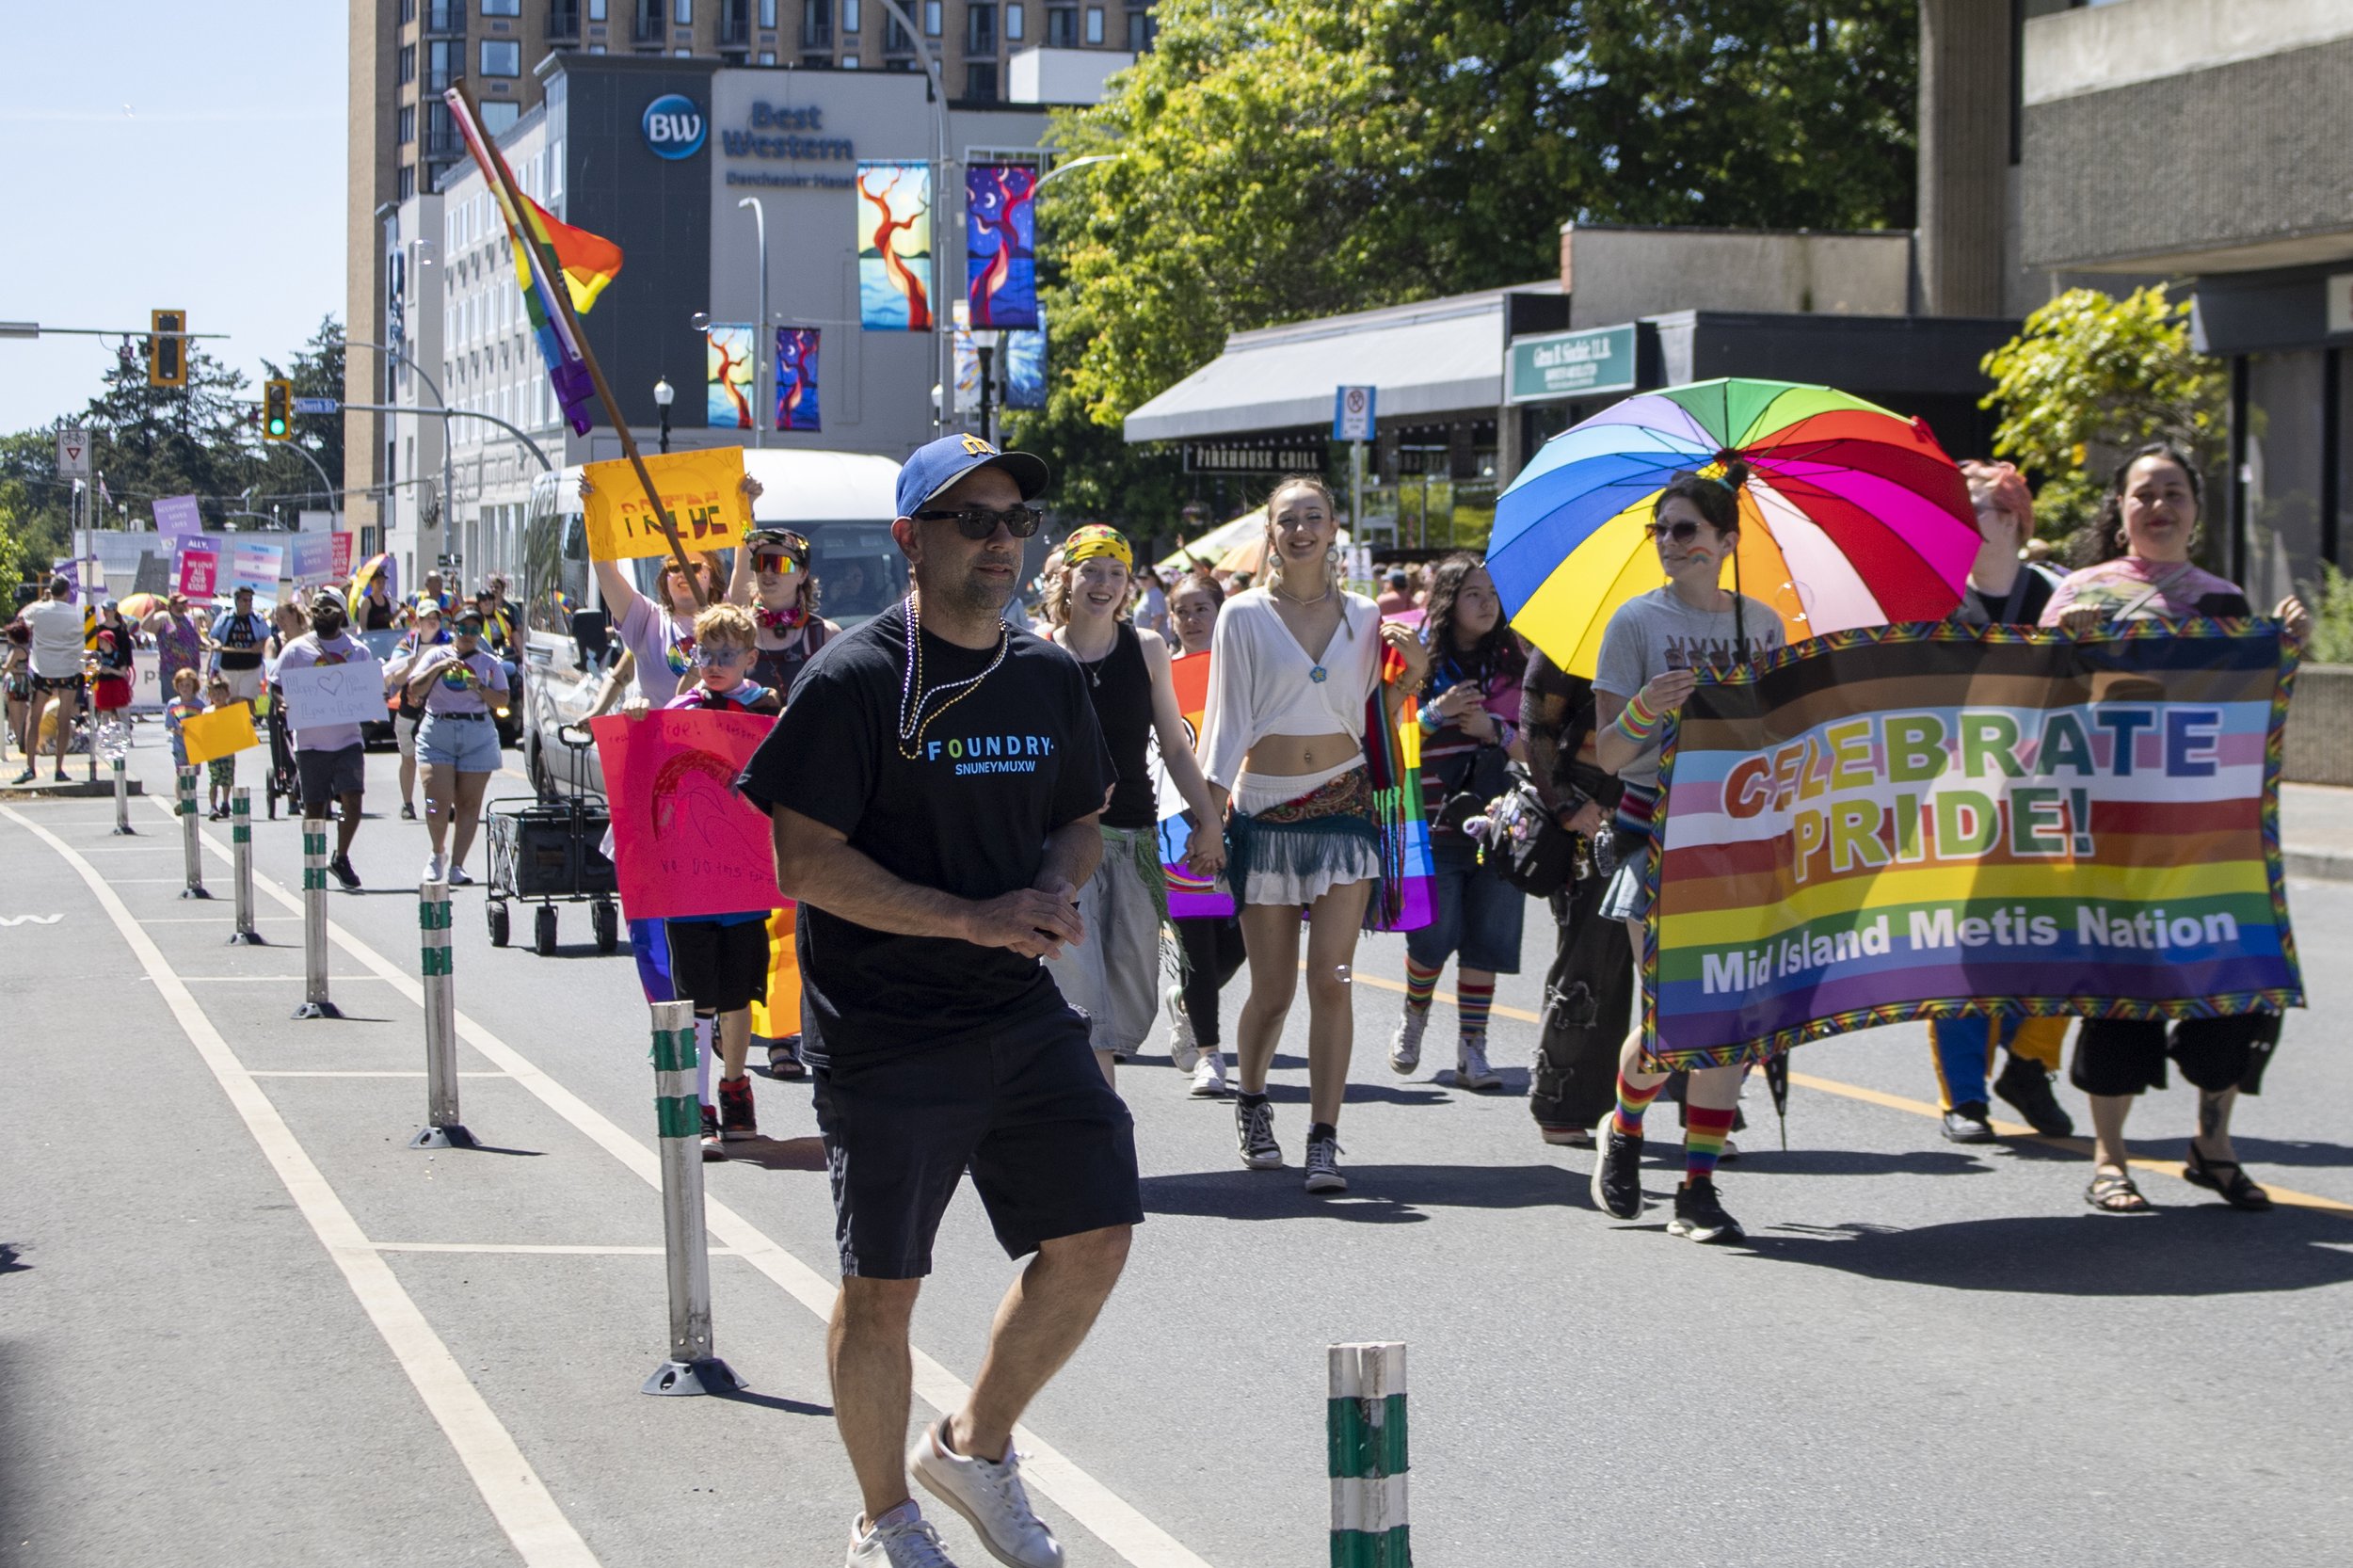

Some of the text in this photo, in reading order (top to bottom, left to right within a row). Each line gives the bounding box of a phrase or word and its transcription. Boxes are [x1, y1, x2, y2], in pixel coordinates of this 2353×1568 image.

[649, 113, 700, 142] BW
[751, 101, 823, 131] Best
[722, 129, 855, 160] Western
[1196, 448, 1320, 470] FIREHOUSE GRILL
[927, 735, 1051, 761] FOUNDRY
[1721, 706, 2223, 820] CELEBRATE
[955, 760, 1035, 776] SNUNEYMUXW
[1794, 786, 2095, 883] PRIDE!
[1702, 905, 2239, 995] Mid Island Metis Nation
